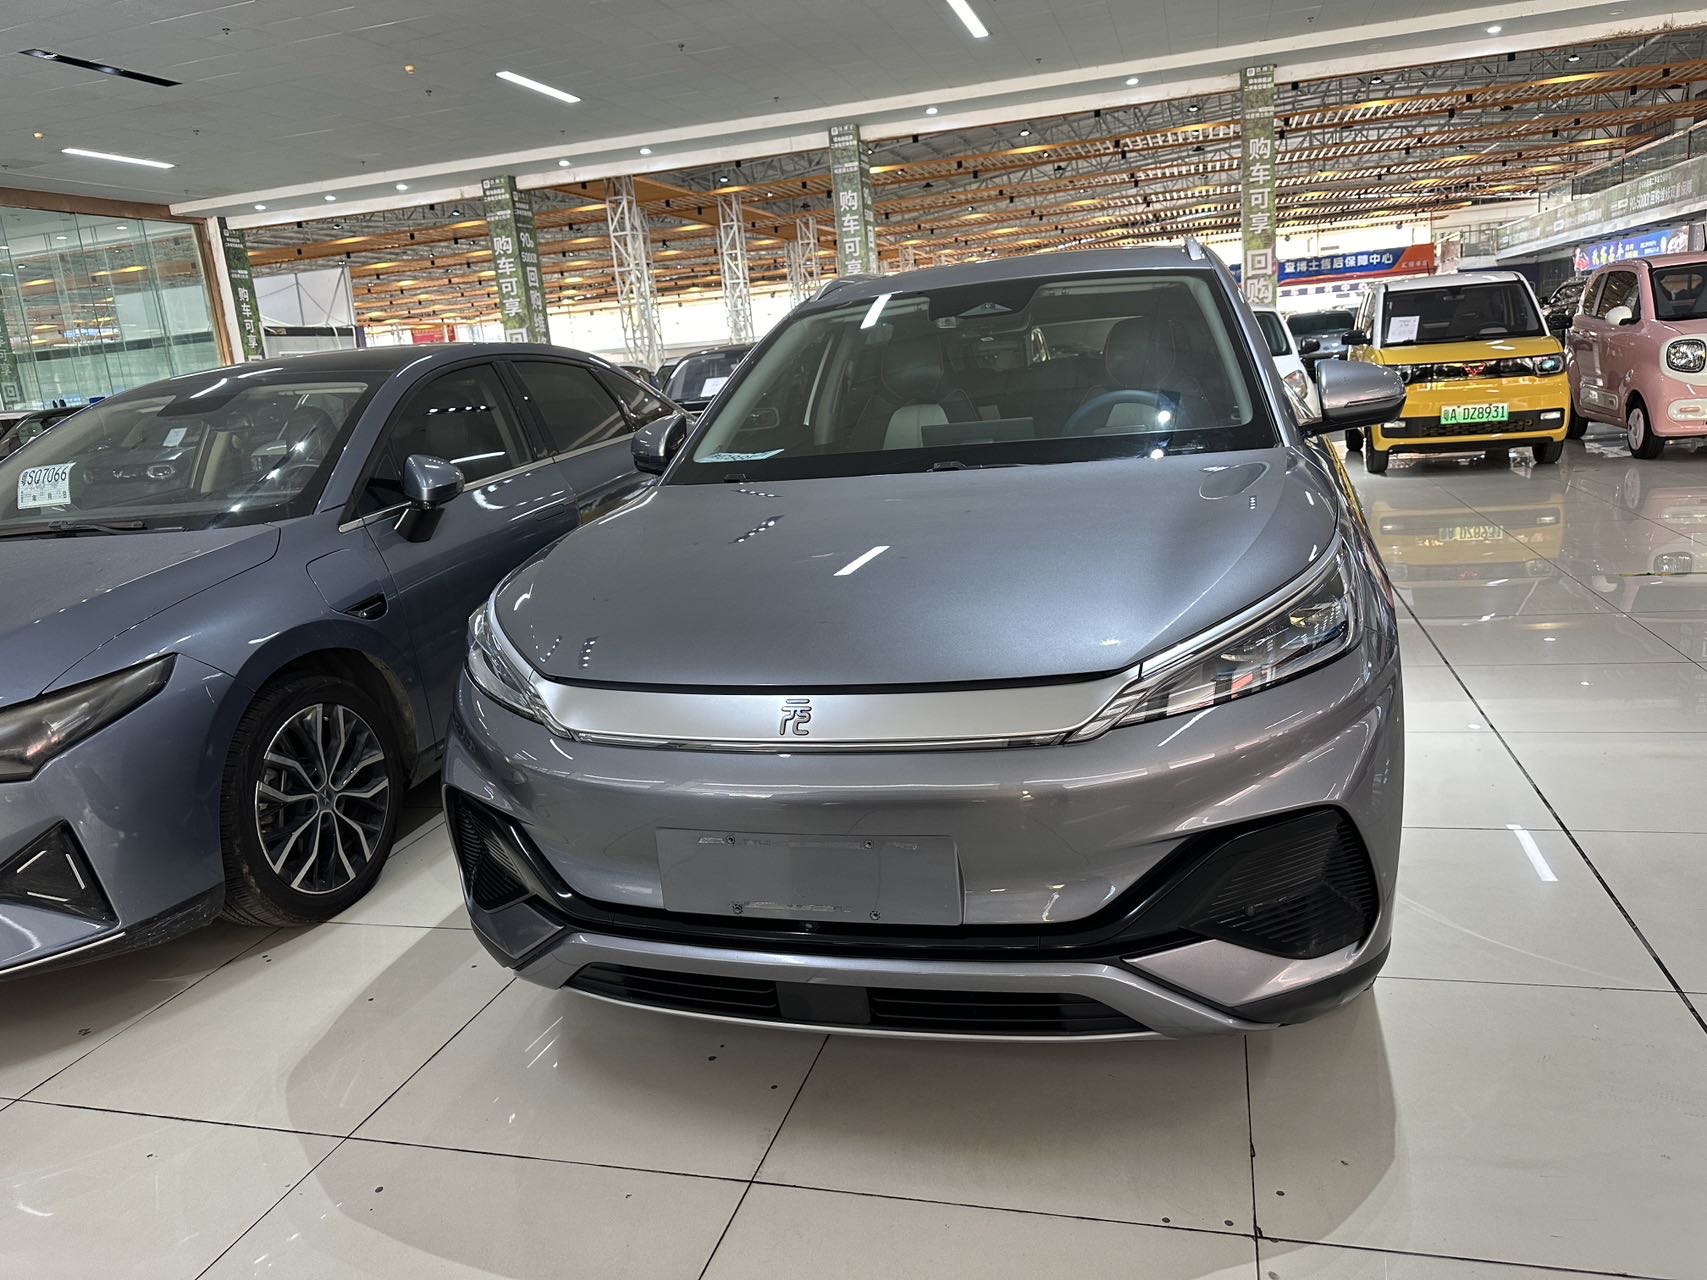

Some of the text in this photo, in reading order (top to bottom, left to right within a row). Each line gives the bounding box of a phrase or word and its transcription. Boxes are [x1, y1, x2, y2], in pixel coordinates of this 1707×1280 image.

[1284, 252, 1394, 274] 查博士售后保障中心
